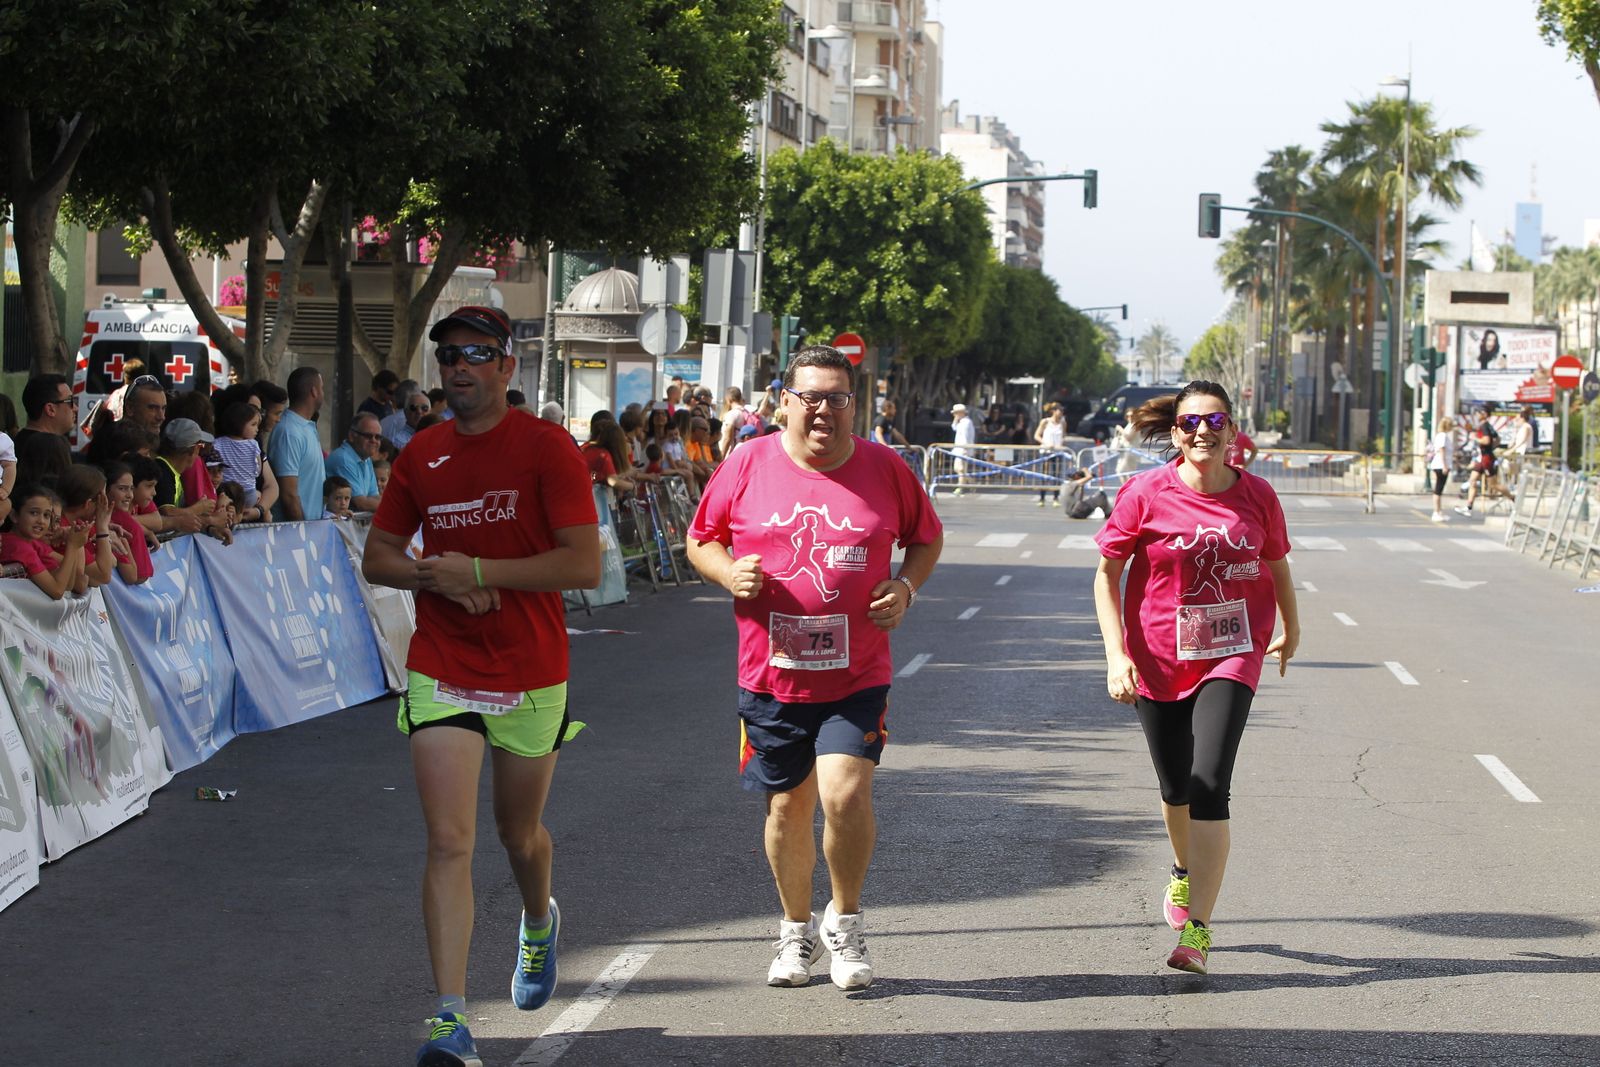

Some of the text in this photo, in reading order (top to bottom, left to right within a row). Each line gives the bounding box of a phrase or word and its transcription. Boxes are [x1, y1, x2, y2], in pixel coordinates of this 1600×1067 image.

[104, 322, 191, 335] AMBULANCIA
[1508, 337, 1552, 350] TODO TIENE
[485, 507, 517, 522] CAR
[823, 546, 834, 569] 4
[1221, 563, 1233, 580] 4
[1210, 617, 1240, 638] 186
[808, 632, 834, 650] 75
